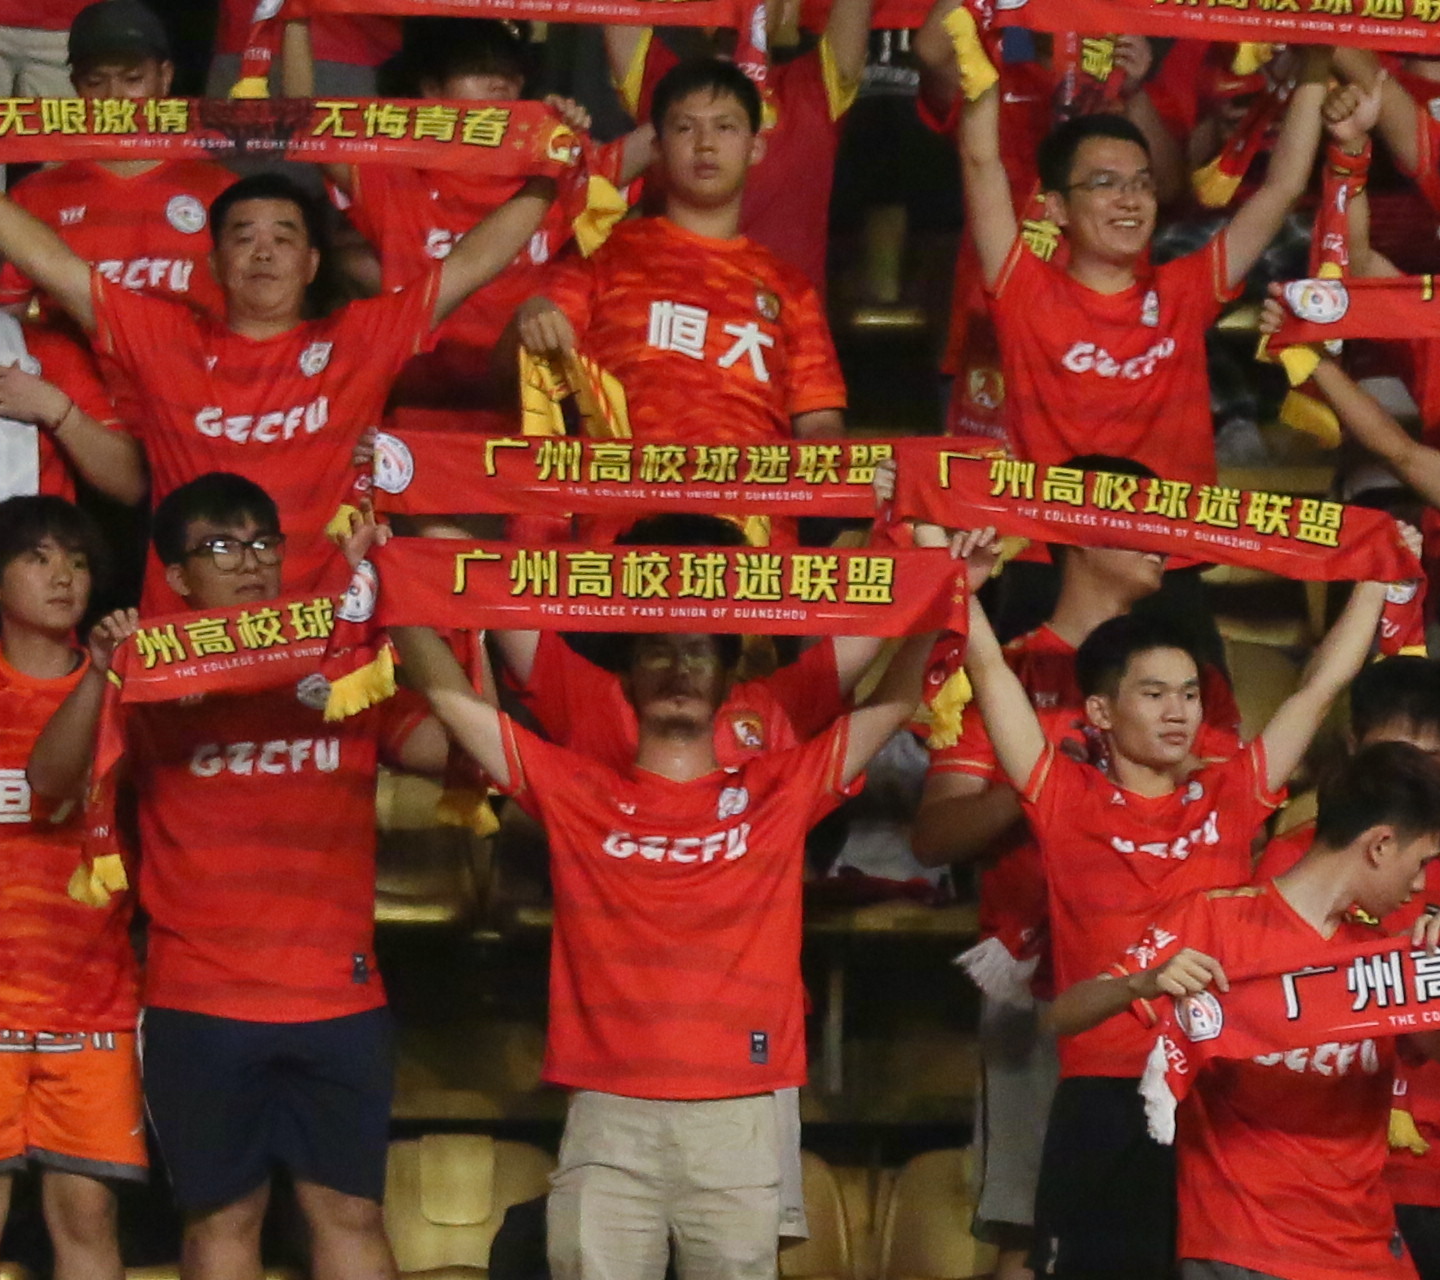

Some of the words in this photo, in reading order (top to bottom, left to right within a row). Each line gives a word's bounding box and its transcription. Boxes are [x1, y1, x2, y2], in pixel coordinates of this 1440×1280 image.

[312, 100, 512, 147] 无悔青春
[649, 300, 774, 383] 恒大
[197, 396, 328, 443] GZCFU
[485, 438, 893, 485] 广州高校球迷联盟
[939, 451, 1343, 548] 广州高校球迷联盟
[1017, 508, 1038, 518] THE
[1045, 509, 1097, 526] COLLEGE
[1102, 516, 1132, 530] FANS
[1137, 521, 1170, 535] UNION
[1175, 526, 1188, 536] OF
[1194, 529, 1262, 552] GUANGZHOU
[453, 550, 895, 604] 广州高校球迷联盟
[540, 604, 564, 614] THE
[569, 605, 625, 616] COLLEGE
[632, 606, 664, 616] FANS
[670, 606, 707, 617] UNION
[712, 608, 728, 618] OF
[734, 608, 807, 620] GUANGZHOU
[194, 739, 339, 778] GZCFU
[604, 824, 751, 865] GZCFU
[1389, 1012, 1413, 1026] THE
